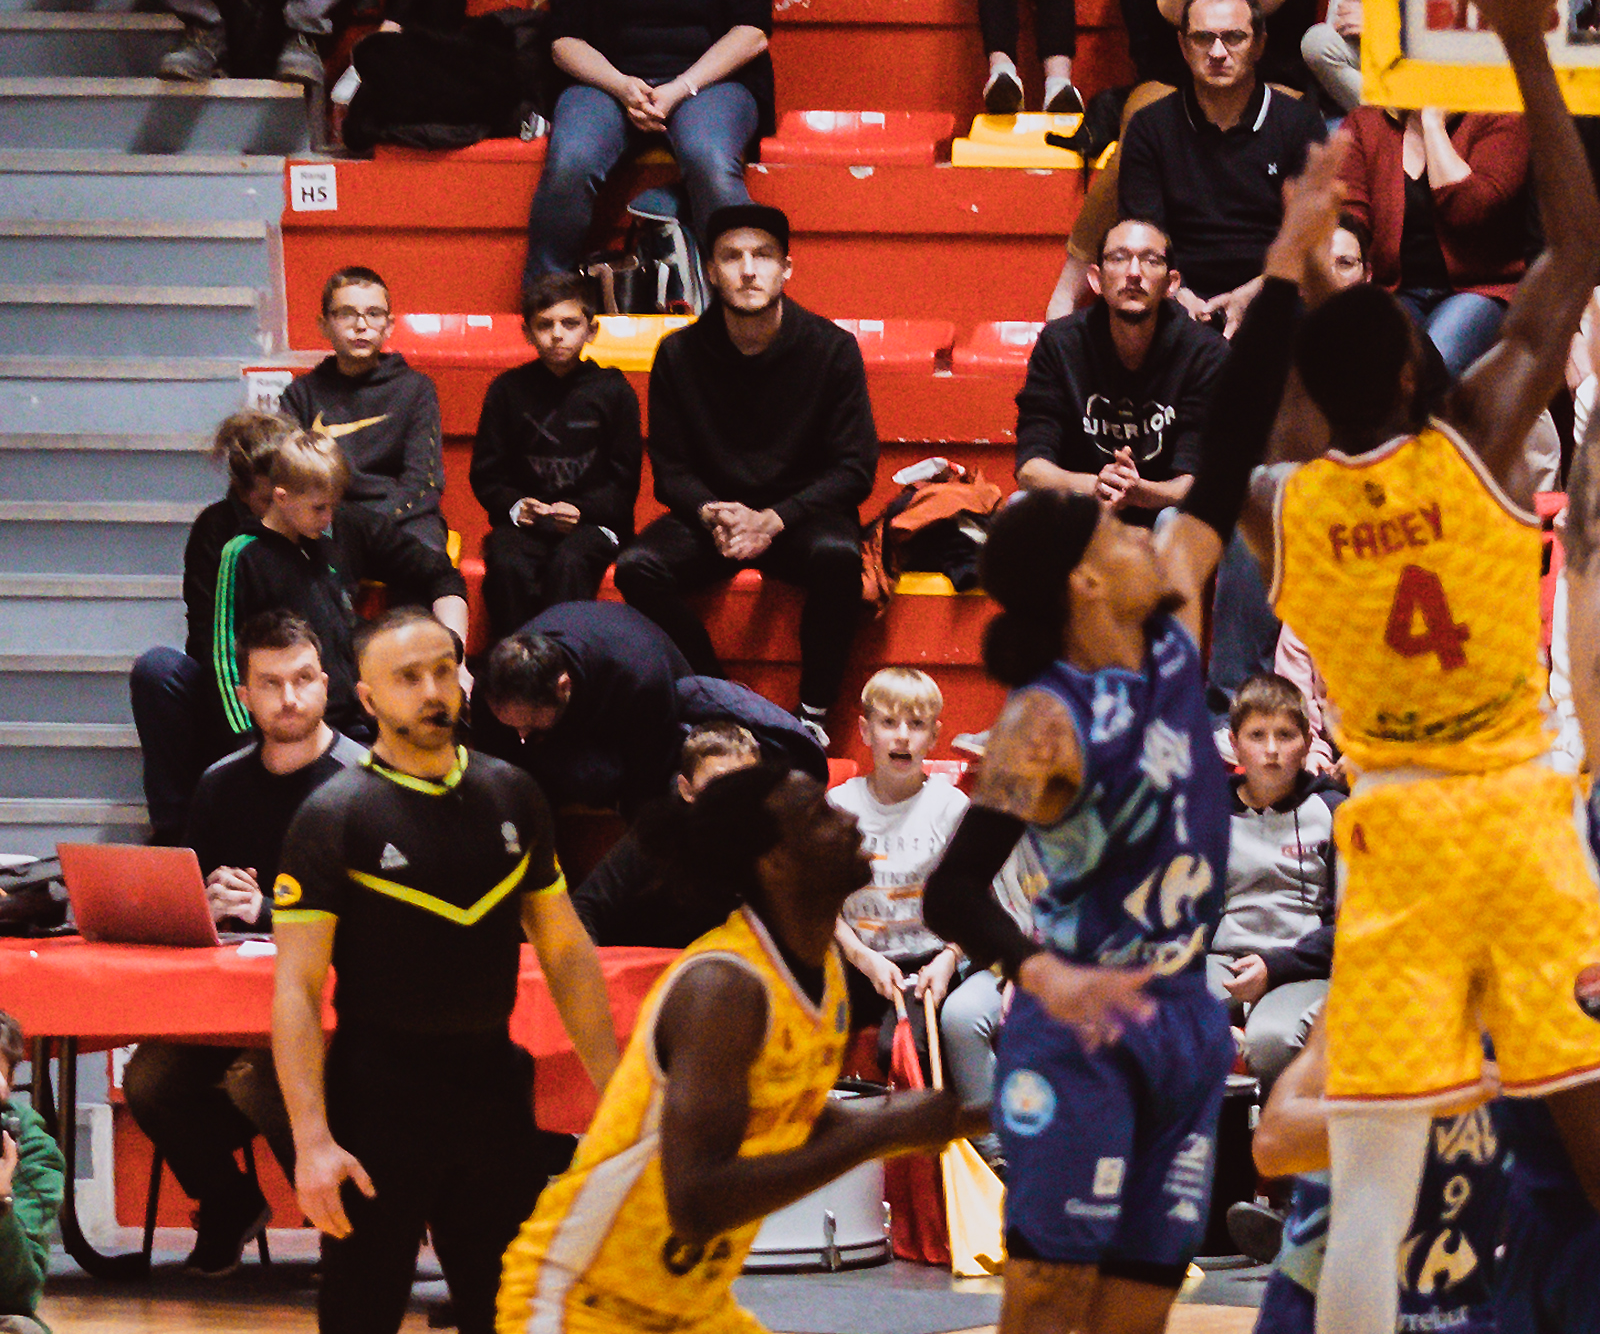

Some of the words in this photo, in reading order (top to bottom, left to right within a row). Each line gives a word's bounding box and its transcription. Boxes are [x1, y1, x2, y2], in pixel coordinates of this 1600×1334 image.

[301, 186, 328, 204] H5
[1328, 502, 1443, 562] FACEY
[1384, 564, 1470, 670] 4
[1442, 1175, 1472, 1220] 9
